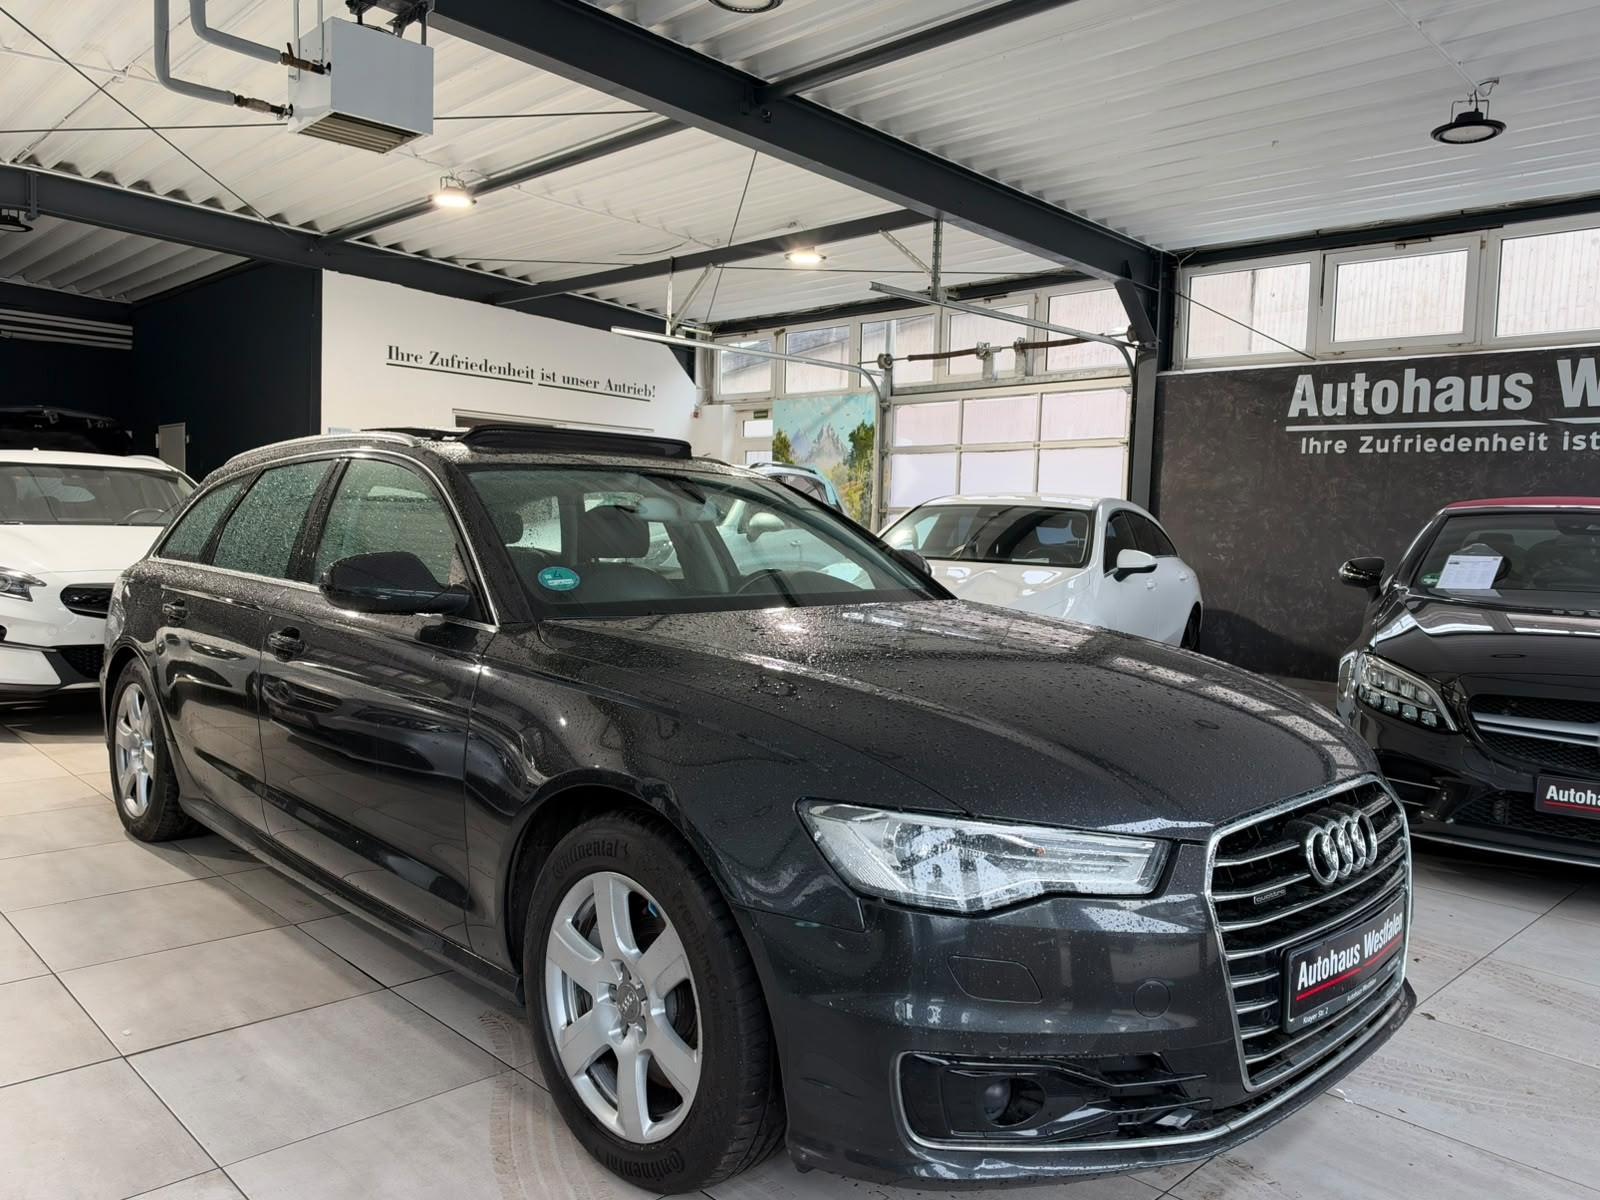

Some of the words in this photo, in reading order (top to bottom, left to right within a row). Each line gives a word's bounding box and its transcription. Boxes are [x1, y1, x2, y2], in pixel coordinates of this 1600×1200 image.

[387, 345, 423, 363] Ihre
[429, 350, 535, 380] Zufriedenheit
[540, 367, 556, 382] ist
[562, 375, 600, 389] unser
[604, 378, 656, 398] Antrieb!
[1288, 368, 1534, 417] Autohaus
[1301, 437, 1347, 454] Ihre
[1359, 432, 1548, 453] Zufriedenheit
[1562, 431, 1600, 451] ist
[552, 840, 619, 878] Continental
[1297, 944, 1361, 991] Autohaus
